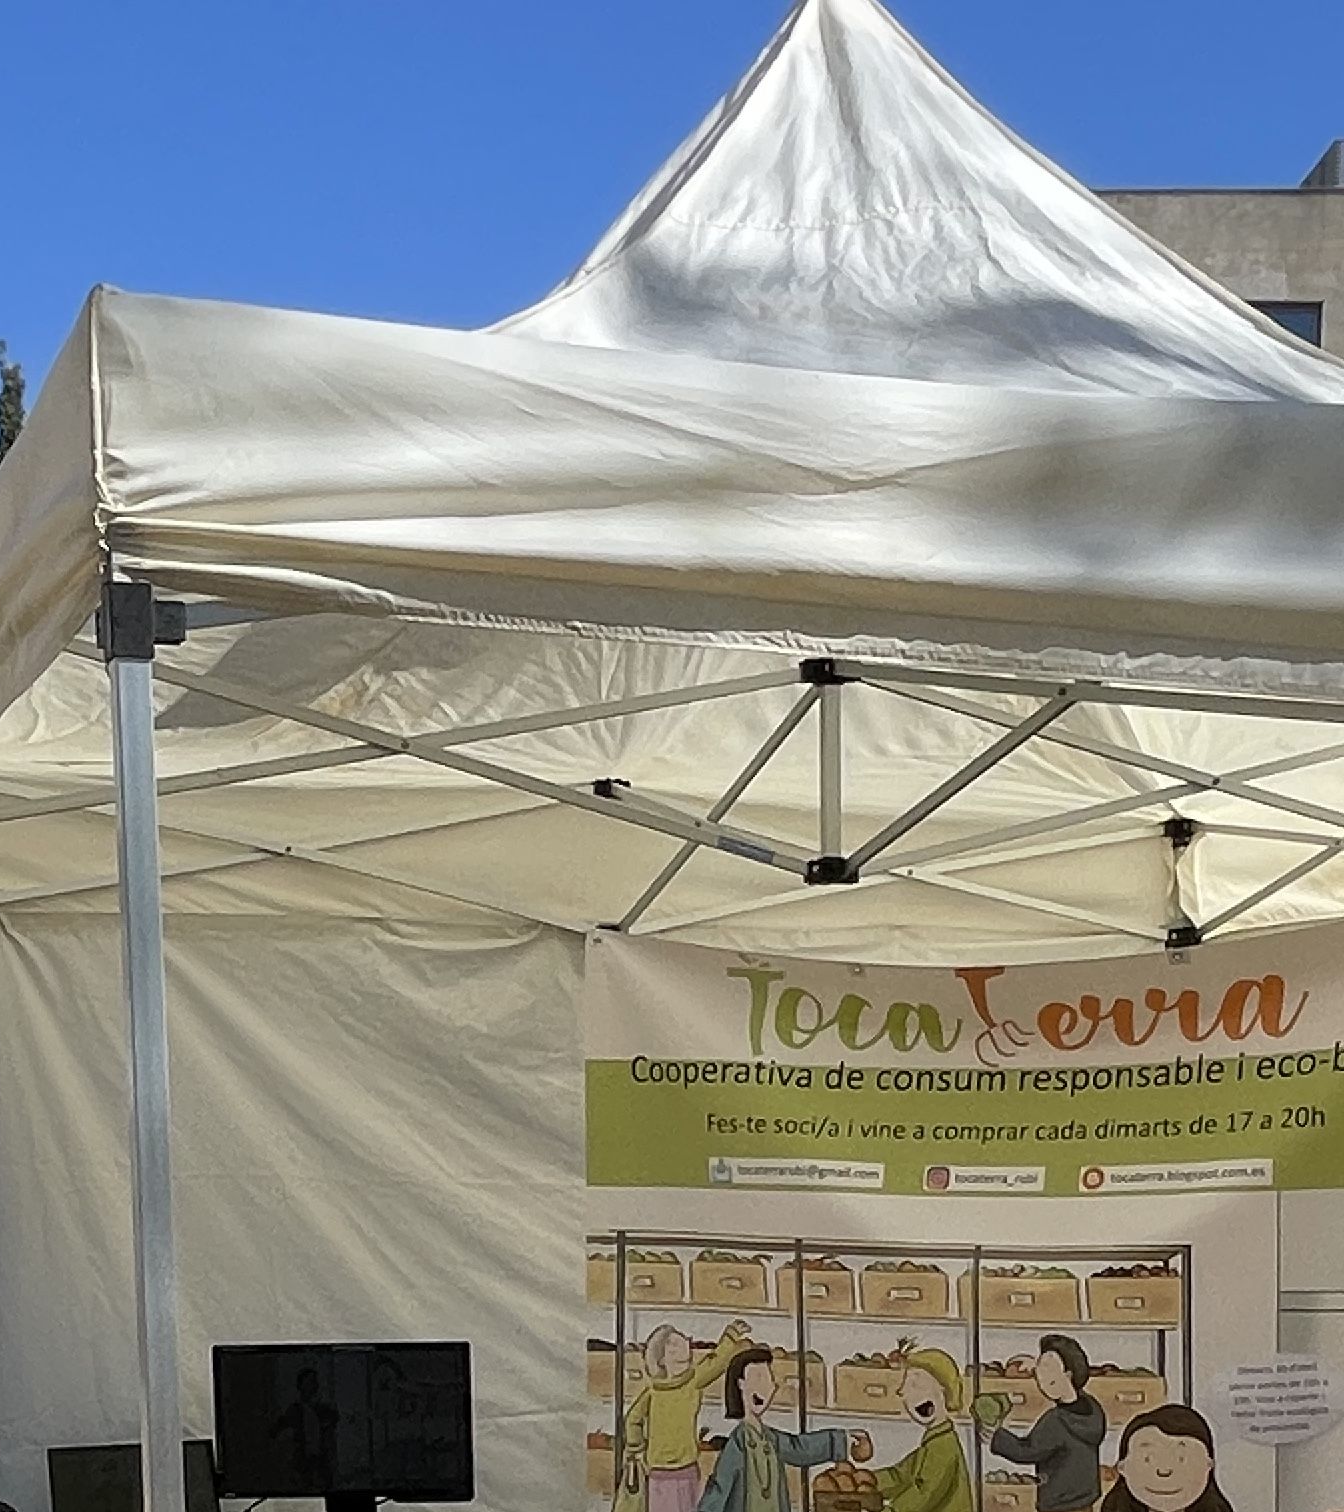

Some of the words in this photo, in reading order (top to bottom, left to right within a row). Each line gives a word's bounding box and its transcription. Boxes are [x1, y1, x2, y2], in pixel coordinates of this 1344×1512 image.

[631, 1055, 813, 1089] Cooperativa
[824, 1061, 864, 1091] de
[876, 1069, 1007, 1092] consum
[1018, 1055, 1225, 1097] responsable
[1236, 1052, 1245, 1081] i
[706, 1113, 767, 1133] Fes-te
[773, 1115, 840, 1139] soci/a
[847, 1117, 854, 1138] i
[860, 1117, 907, 1140] vine
[912, 1125, 924, 1140] a
[932, 1123, 1028, 1144] comprar
[1035, 1119, 1087, 1141] cada
[1094, 1115, 1182, 1140] dimarts
[1188, 1113, 1218, 1136] de
[1226, 1111, 1253, 1133] 17
[1259, 1113, 1272, 1130] a
[1280, 1105, 1326, 1129] 20h
